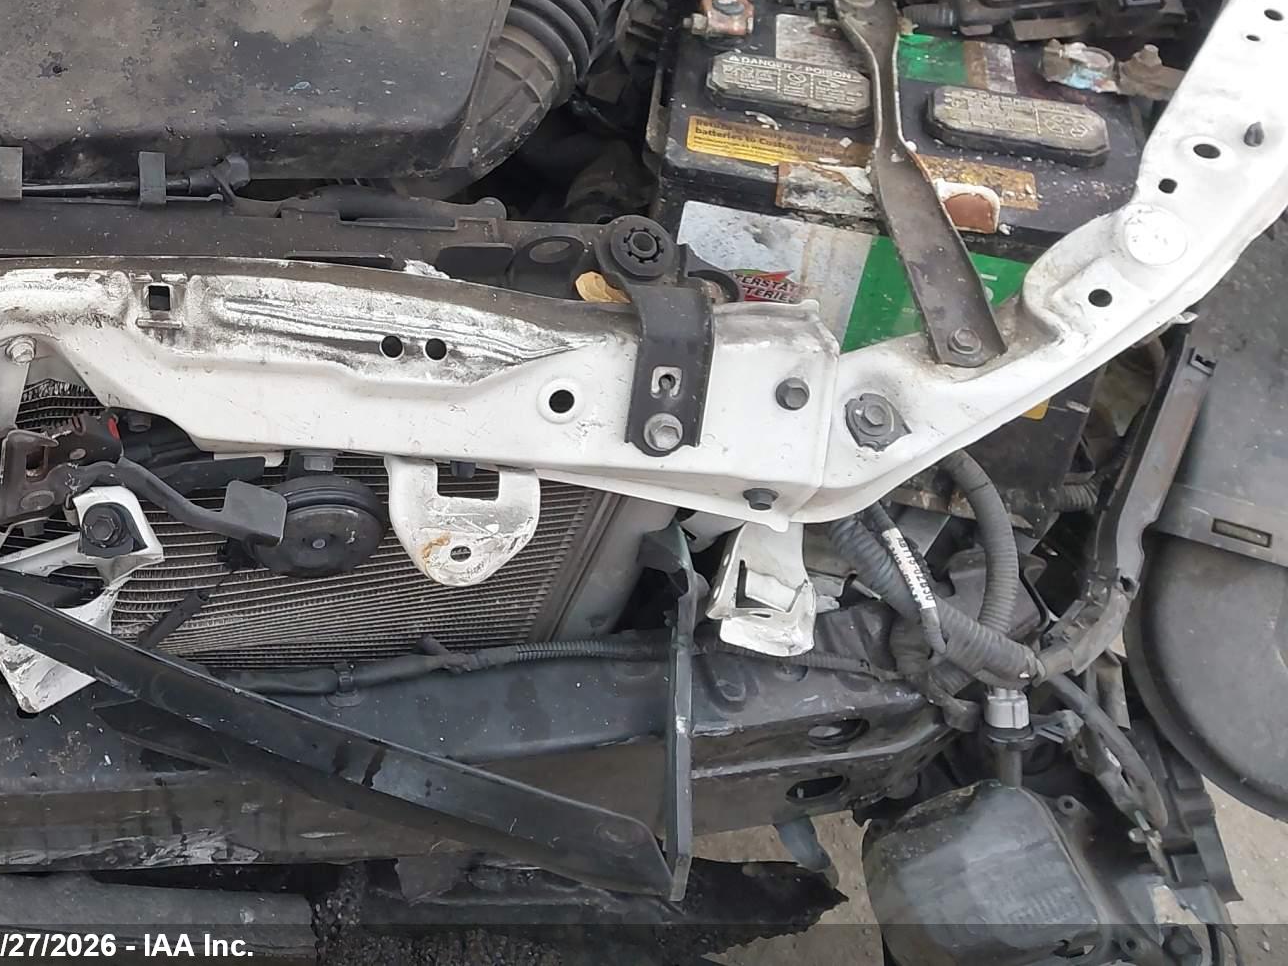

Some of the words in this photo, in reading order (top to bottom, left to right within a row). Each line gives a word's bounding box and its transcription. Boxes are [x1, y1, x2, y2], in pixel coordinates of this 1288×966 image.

[741, 57, 793, 70] DANGER
[805, 66, 852, 79] POISON
[695, 126, 743, 142] batteries
[759, 137, 795, 150] Costco
[742, 285, 801, 304] TERIES
